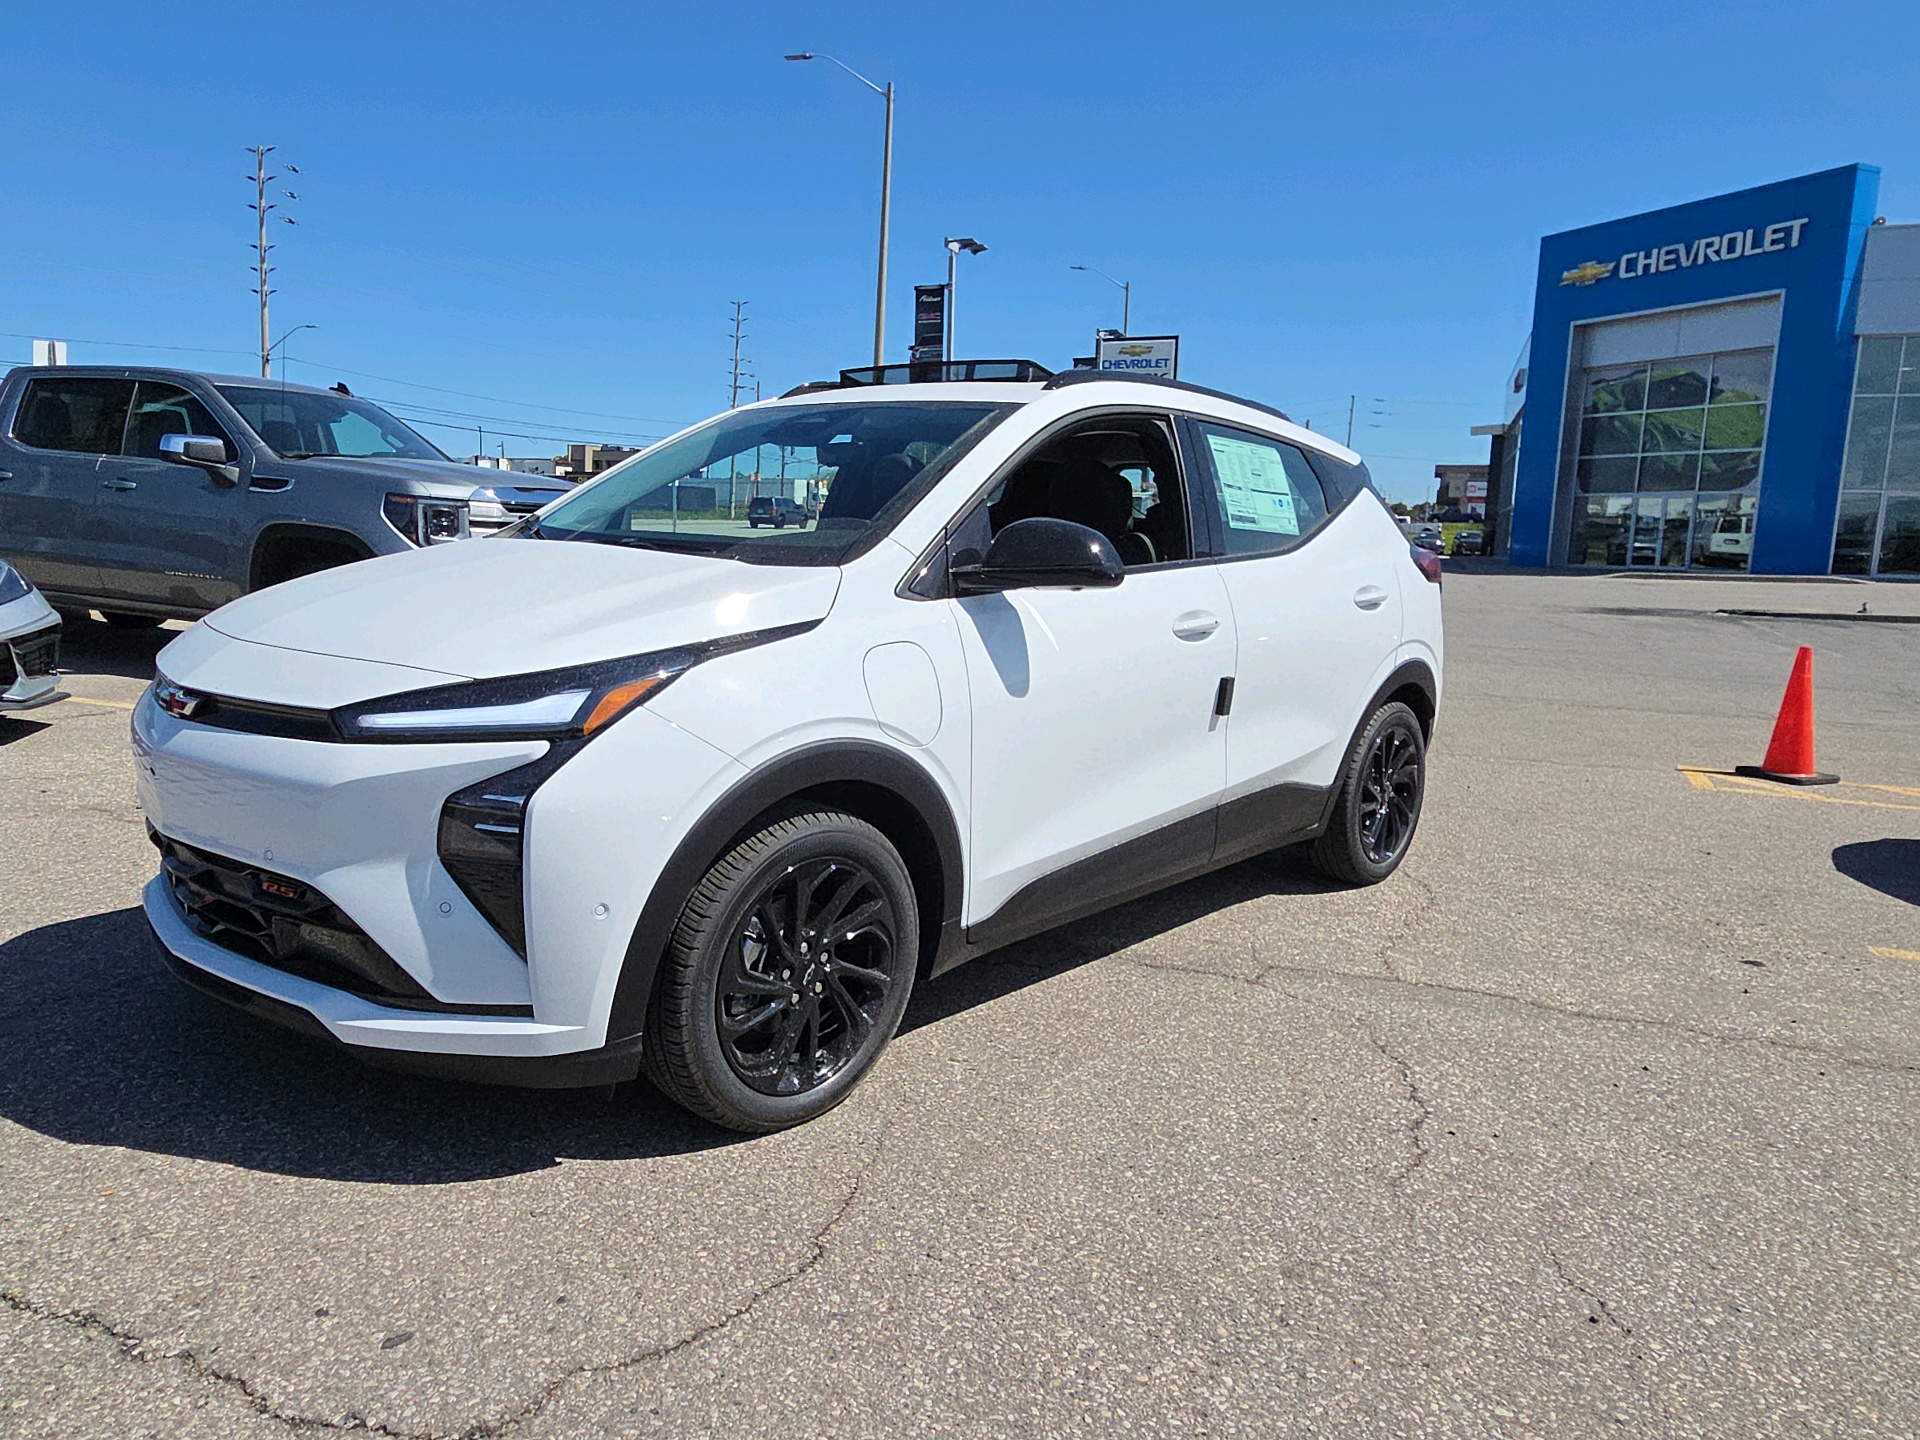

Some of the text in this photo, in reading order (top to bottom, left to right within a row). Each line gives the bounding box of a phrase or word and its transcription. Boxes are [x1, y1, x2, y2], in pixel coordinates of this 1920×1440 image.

[1619, 217, 1809, 279] CHEVROLET
[1102, 358, 1170, 369] CHEVROLET
[262, 881, 296, 898] RS
